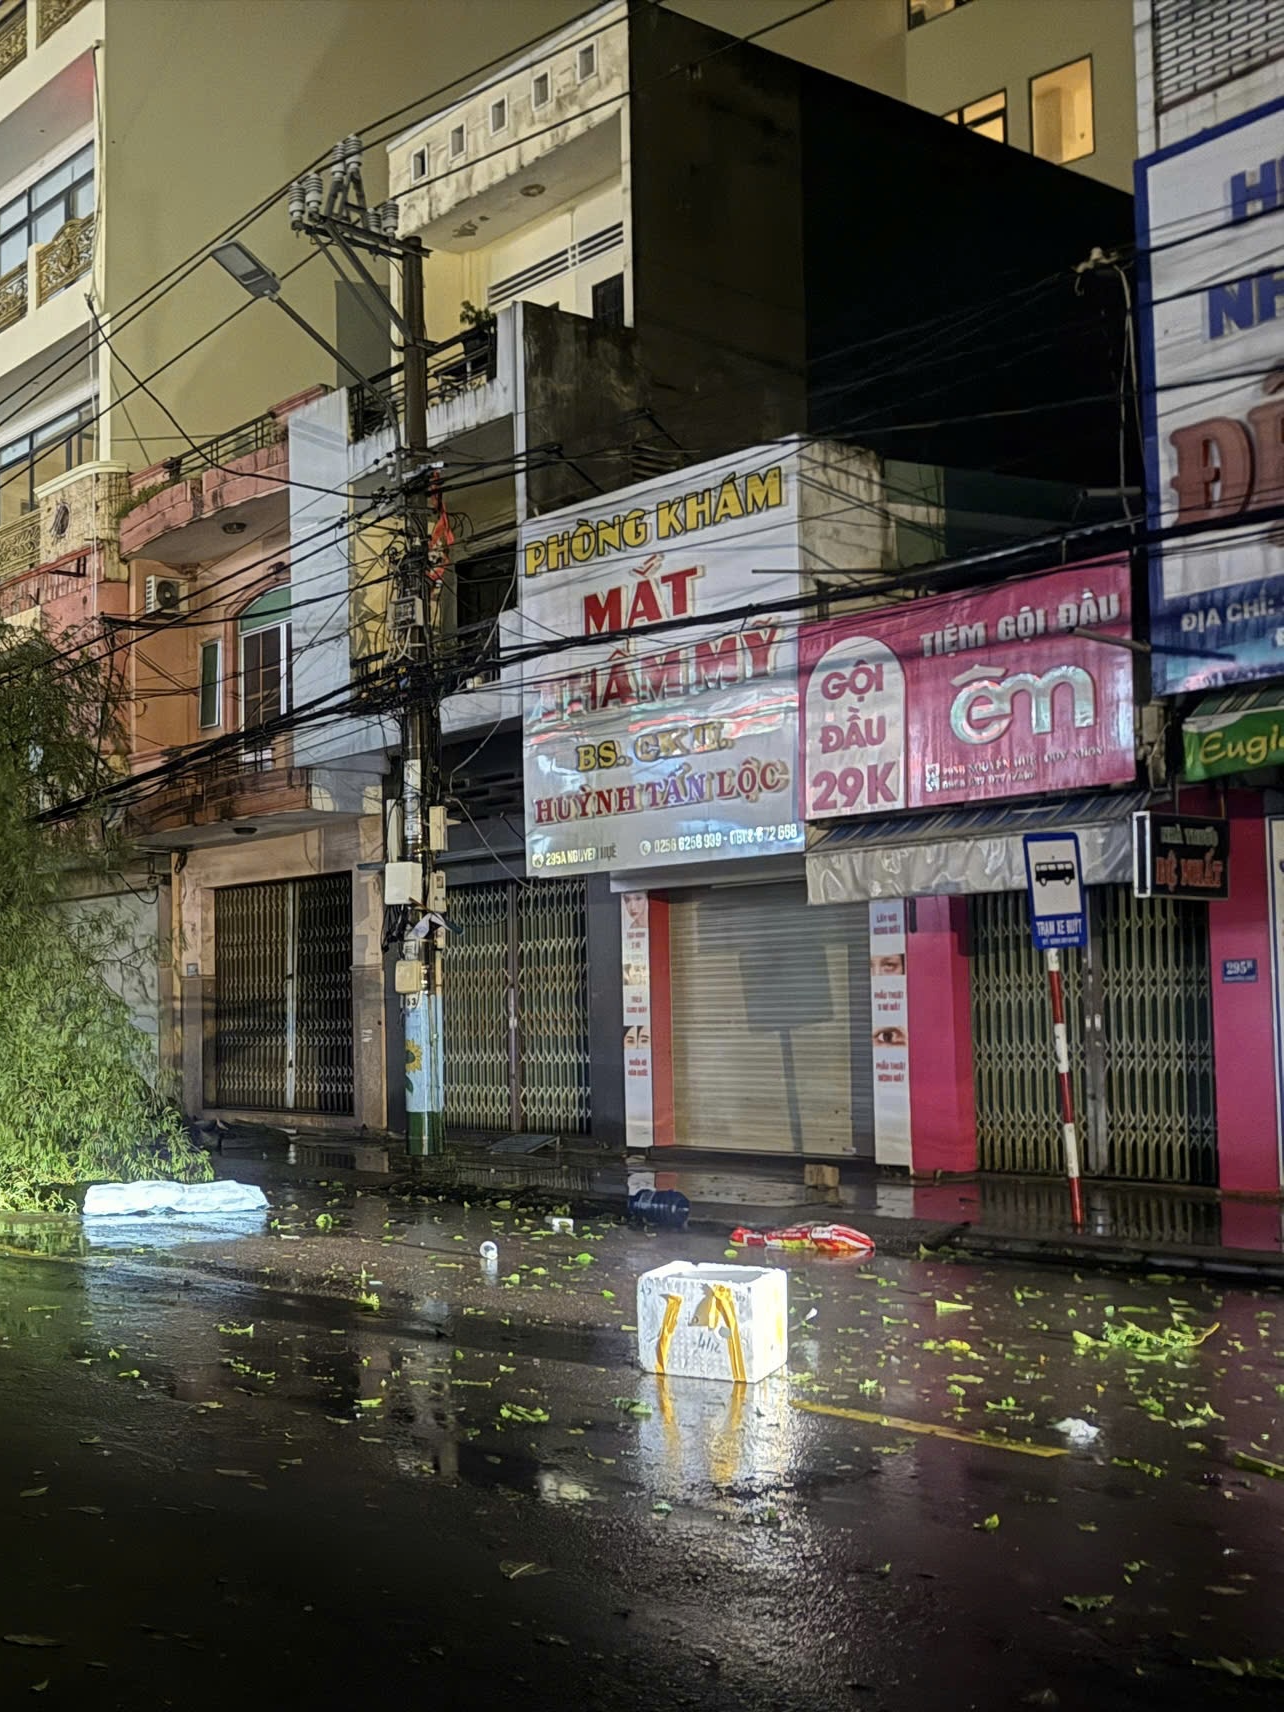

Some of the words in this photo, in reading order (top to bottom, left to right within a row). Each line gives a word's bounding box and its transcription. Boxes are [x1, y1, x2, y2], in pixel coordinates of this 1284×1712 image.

[525, 508, 648, 577] PHÒNG
[657, 465, 783, 540] KHÁM
[583, 553, 705, 636] MẮT
[920, 622, 986, 657] TIỆM
[997, 605, 1047, 643] GỘI
[1058, 587, 1121, 630] ĐẦU
[821, 659, 885, 702] GỘI
[819, 706, 887, 754] ĐẦU
[534, 785, 642, 825] HUỲNH
[812, 761, 898, 811] 29K
[1056, 919, 1066, 935] XE
